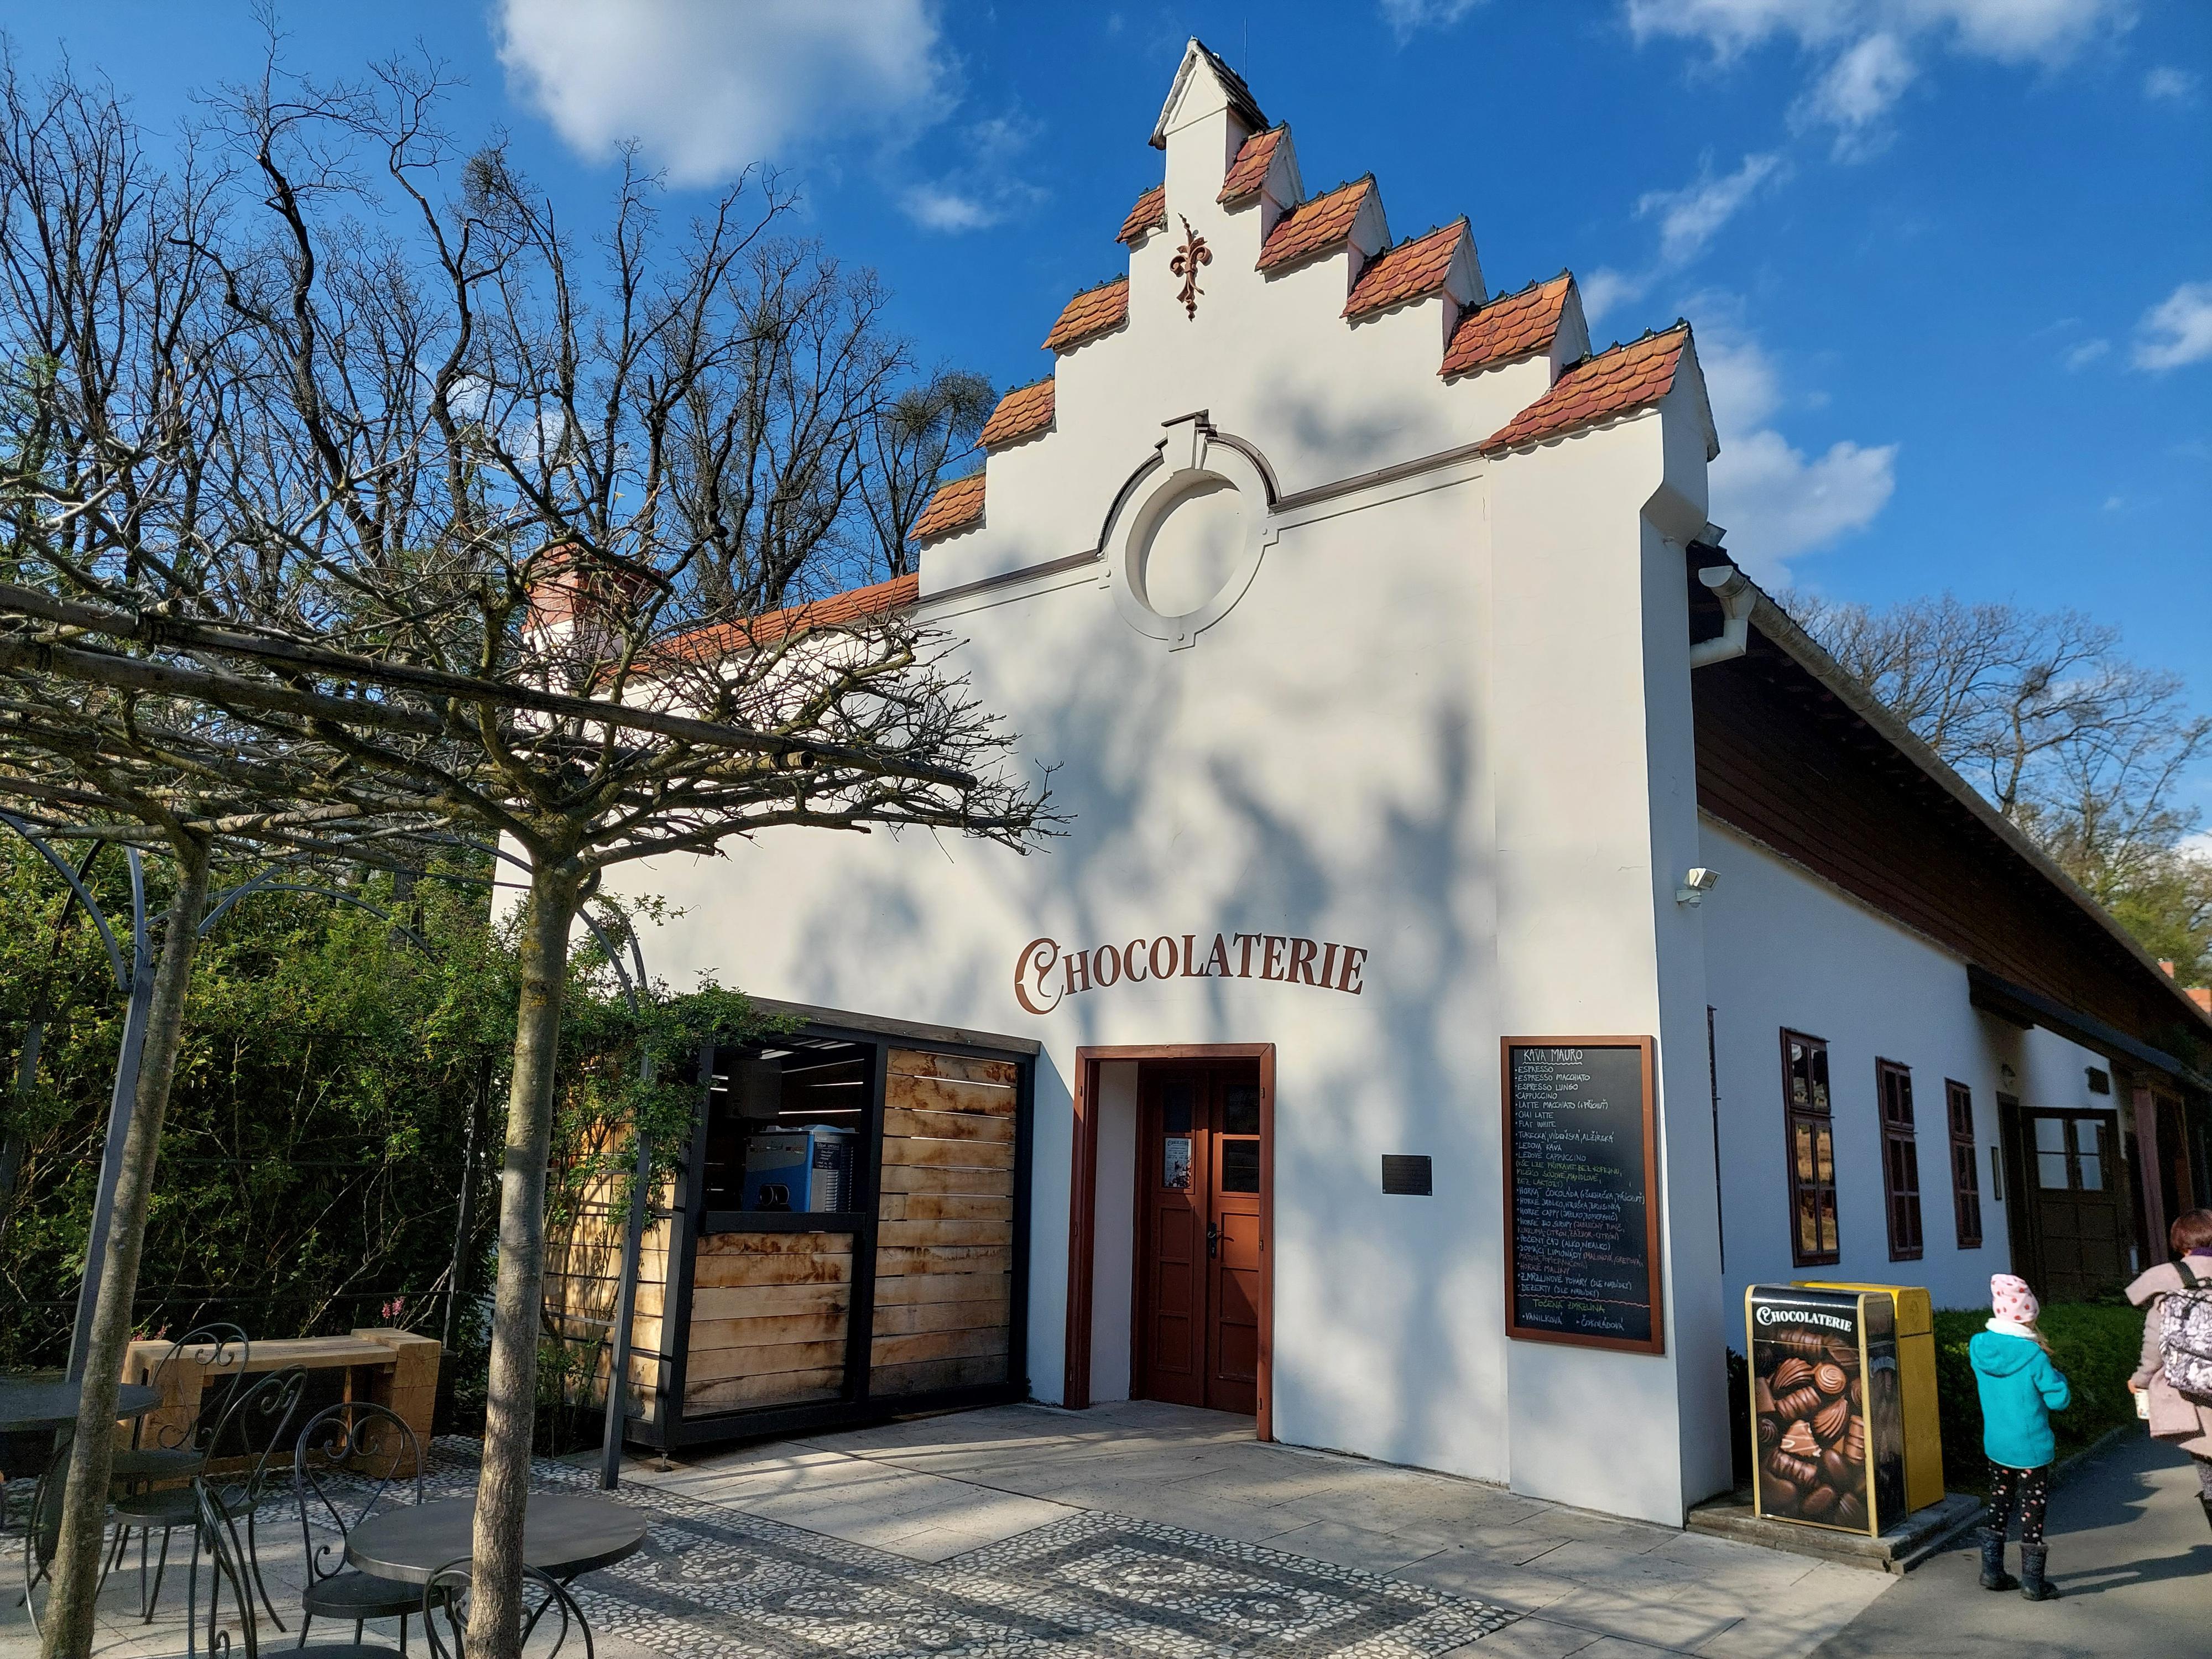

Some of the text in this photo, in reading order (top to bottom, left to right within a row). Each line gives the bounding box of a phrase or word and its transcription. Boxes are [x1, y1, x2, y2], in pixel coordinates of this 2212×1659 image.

[1014, 932, 1368, 1015] CHOCOLATERIE
[1524, 1048, 1583, 1062] KÁVA MAURO
[1556, 1074, 1590, 1082] MACCHIATO
[1543, 1101, 1575, 1109] MACCHIATO
[1546, 1141, 1562, 1151] KÁVA
[1546, 1153, 1586, 1161] CAPPUCCINO
[1756, 1306, 1852, 1332] CHOCOLATERIE
